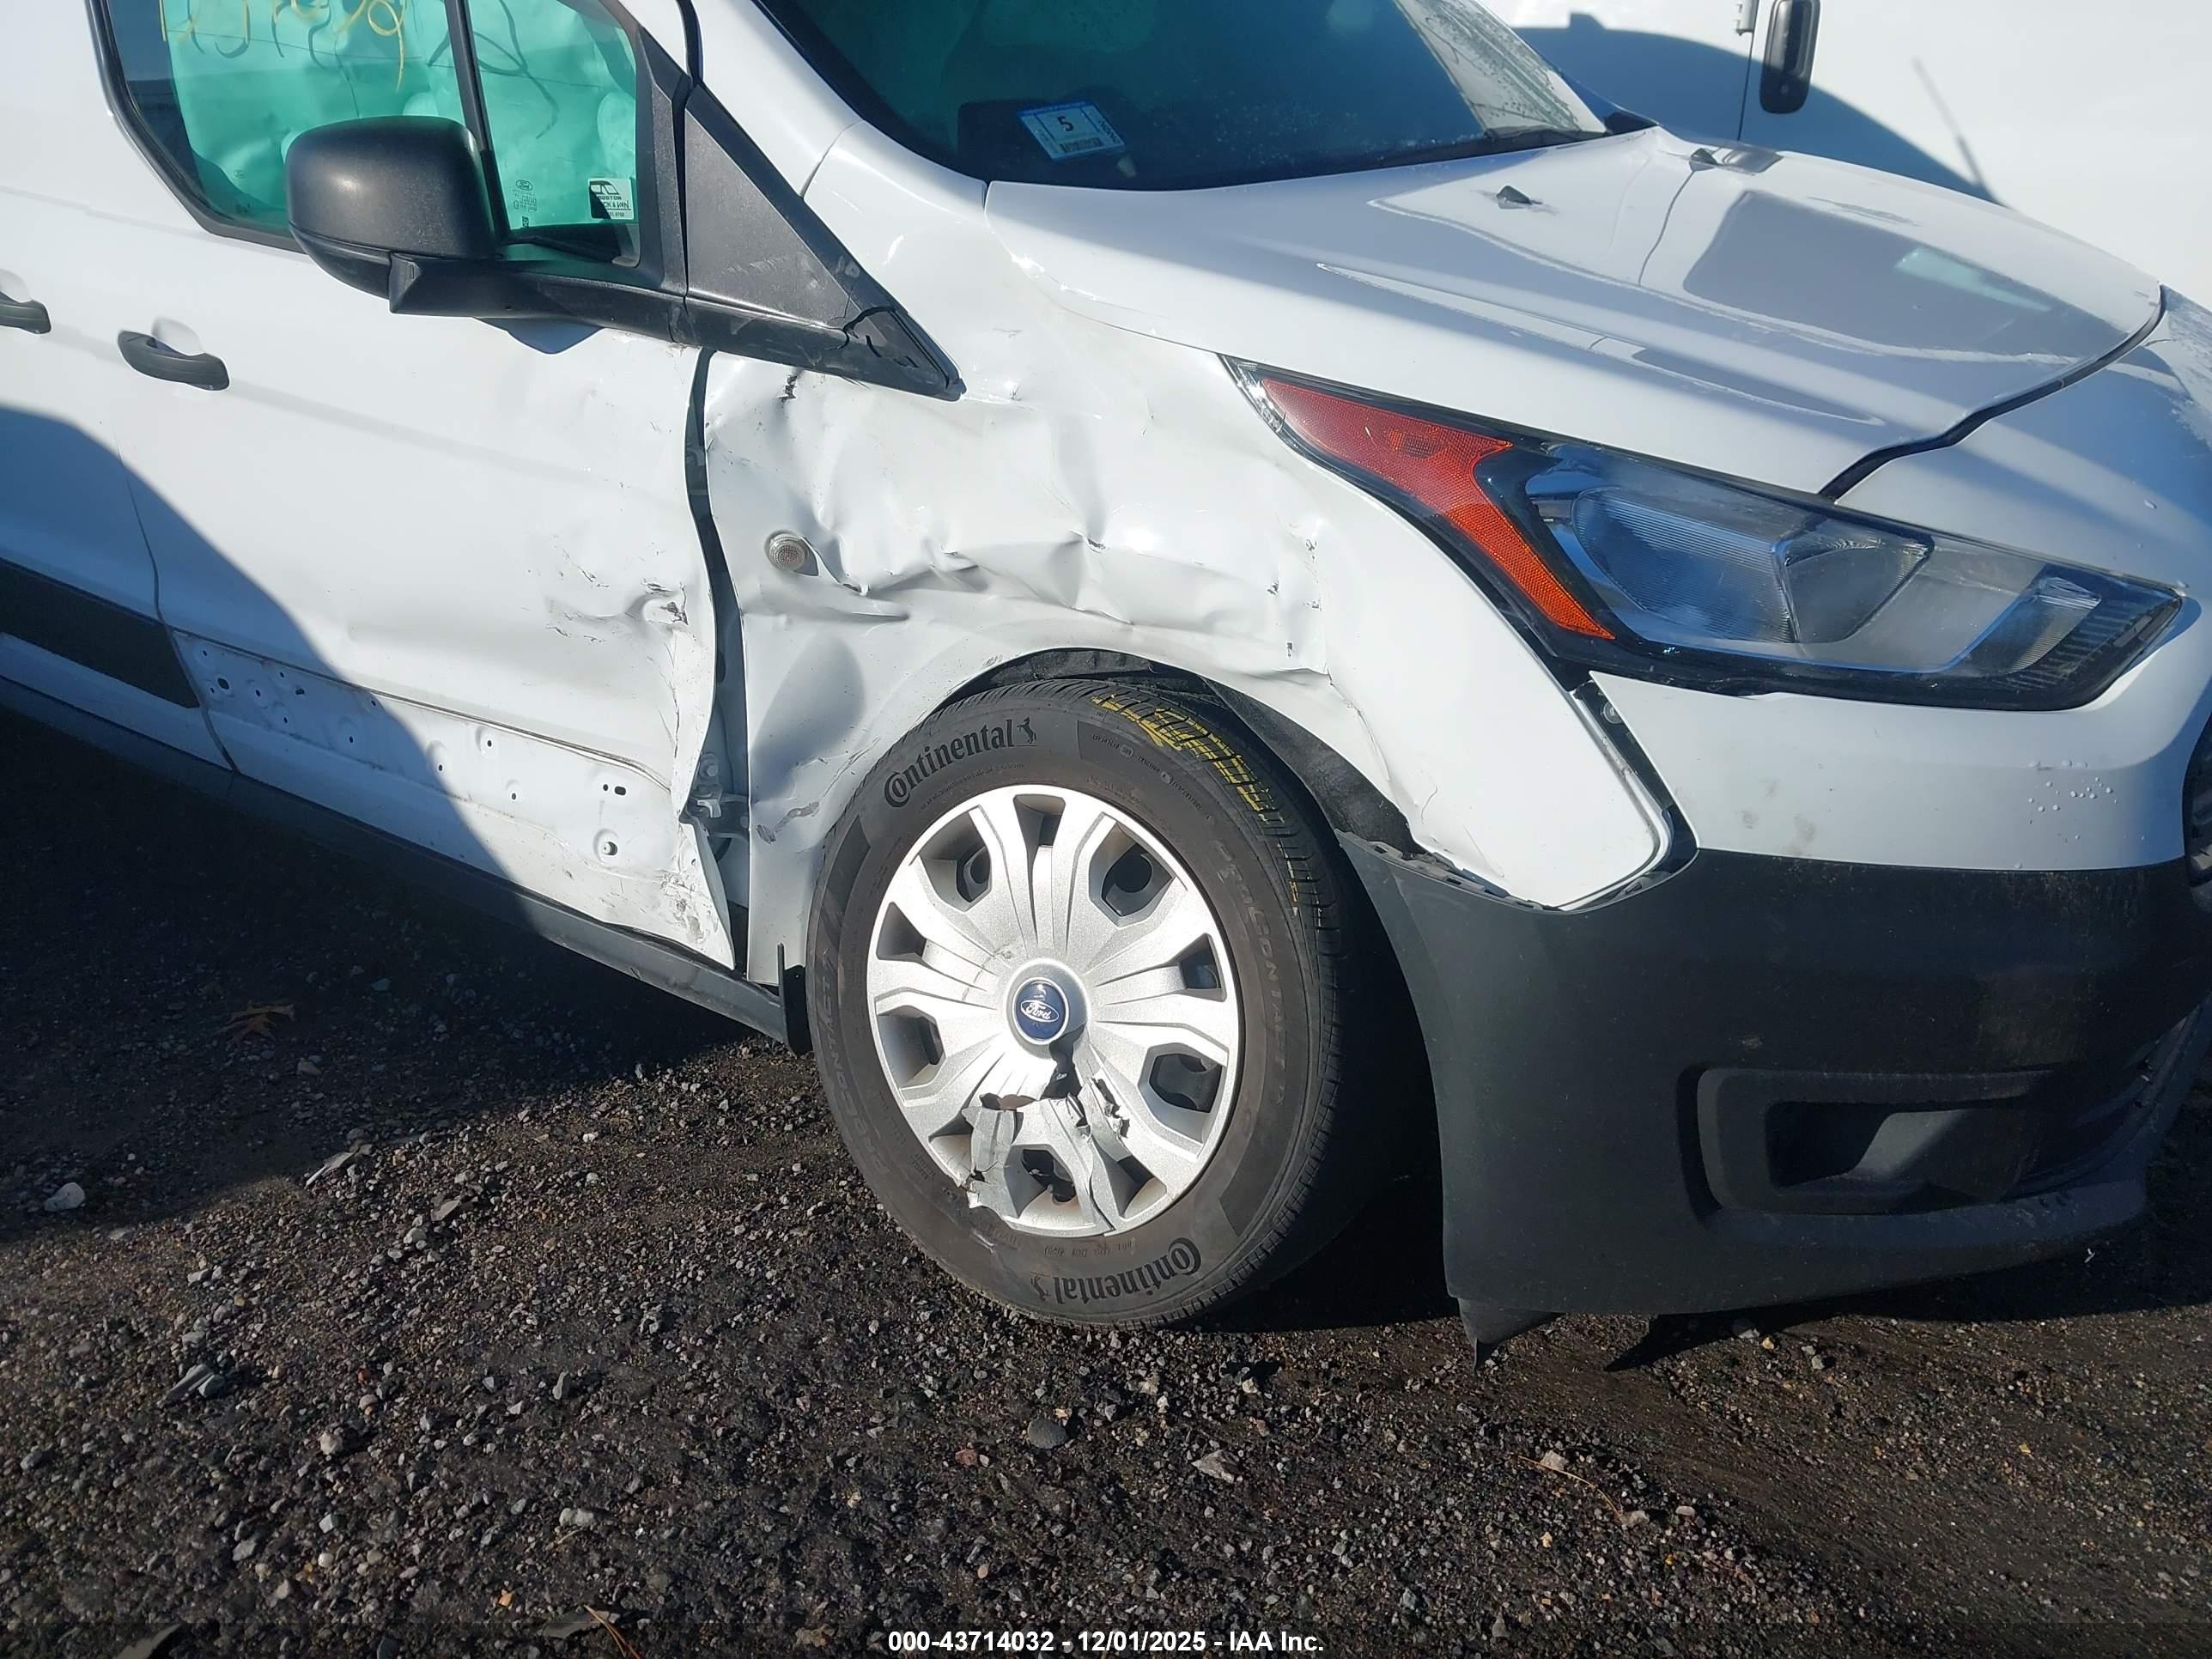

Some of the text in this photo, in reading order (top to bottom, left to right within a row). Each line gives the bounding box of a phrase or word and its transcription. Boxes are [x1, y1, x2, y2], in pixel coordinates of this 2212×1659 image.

[1057, 116, 1073, 131] 5
[884, 719, 1015, 808] Continental
[1025, 1002, 1052, 1020] Ford
[1053, 1237, 1201, 1305] Continental
